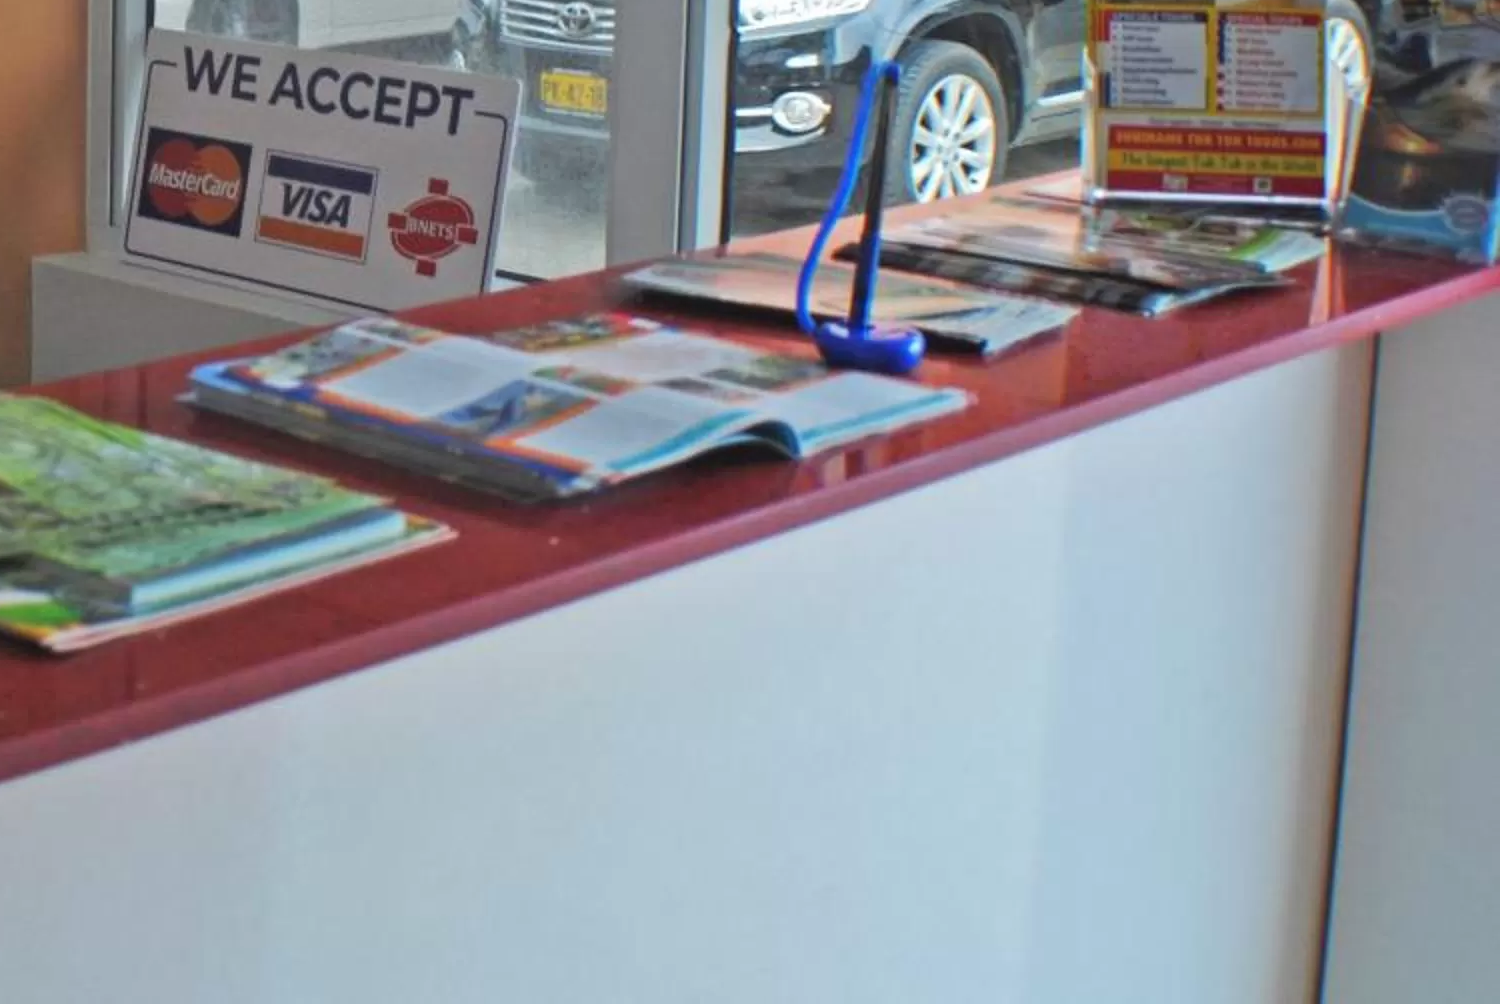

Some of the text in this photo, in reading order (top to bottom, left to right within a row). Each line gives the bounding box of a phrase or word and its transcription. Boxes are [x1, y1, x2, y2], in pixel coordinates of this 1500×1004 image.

[184, 45, 474, 136] WE ACCEPT
[148, 162, 241, 201] MasterCard
[280, 182, 351, 229] VISA
